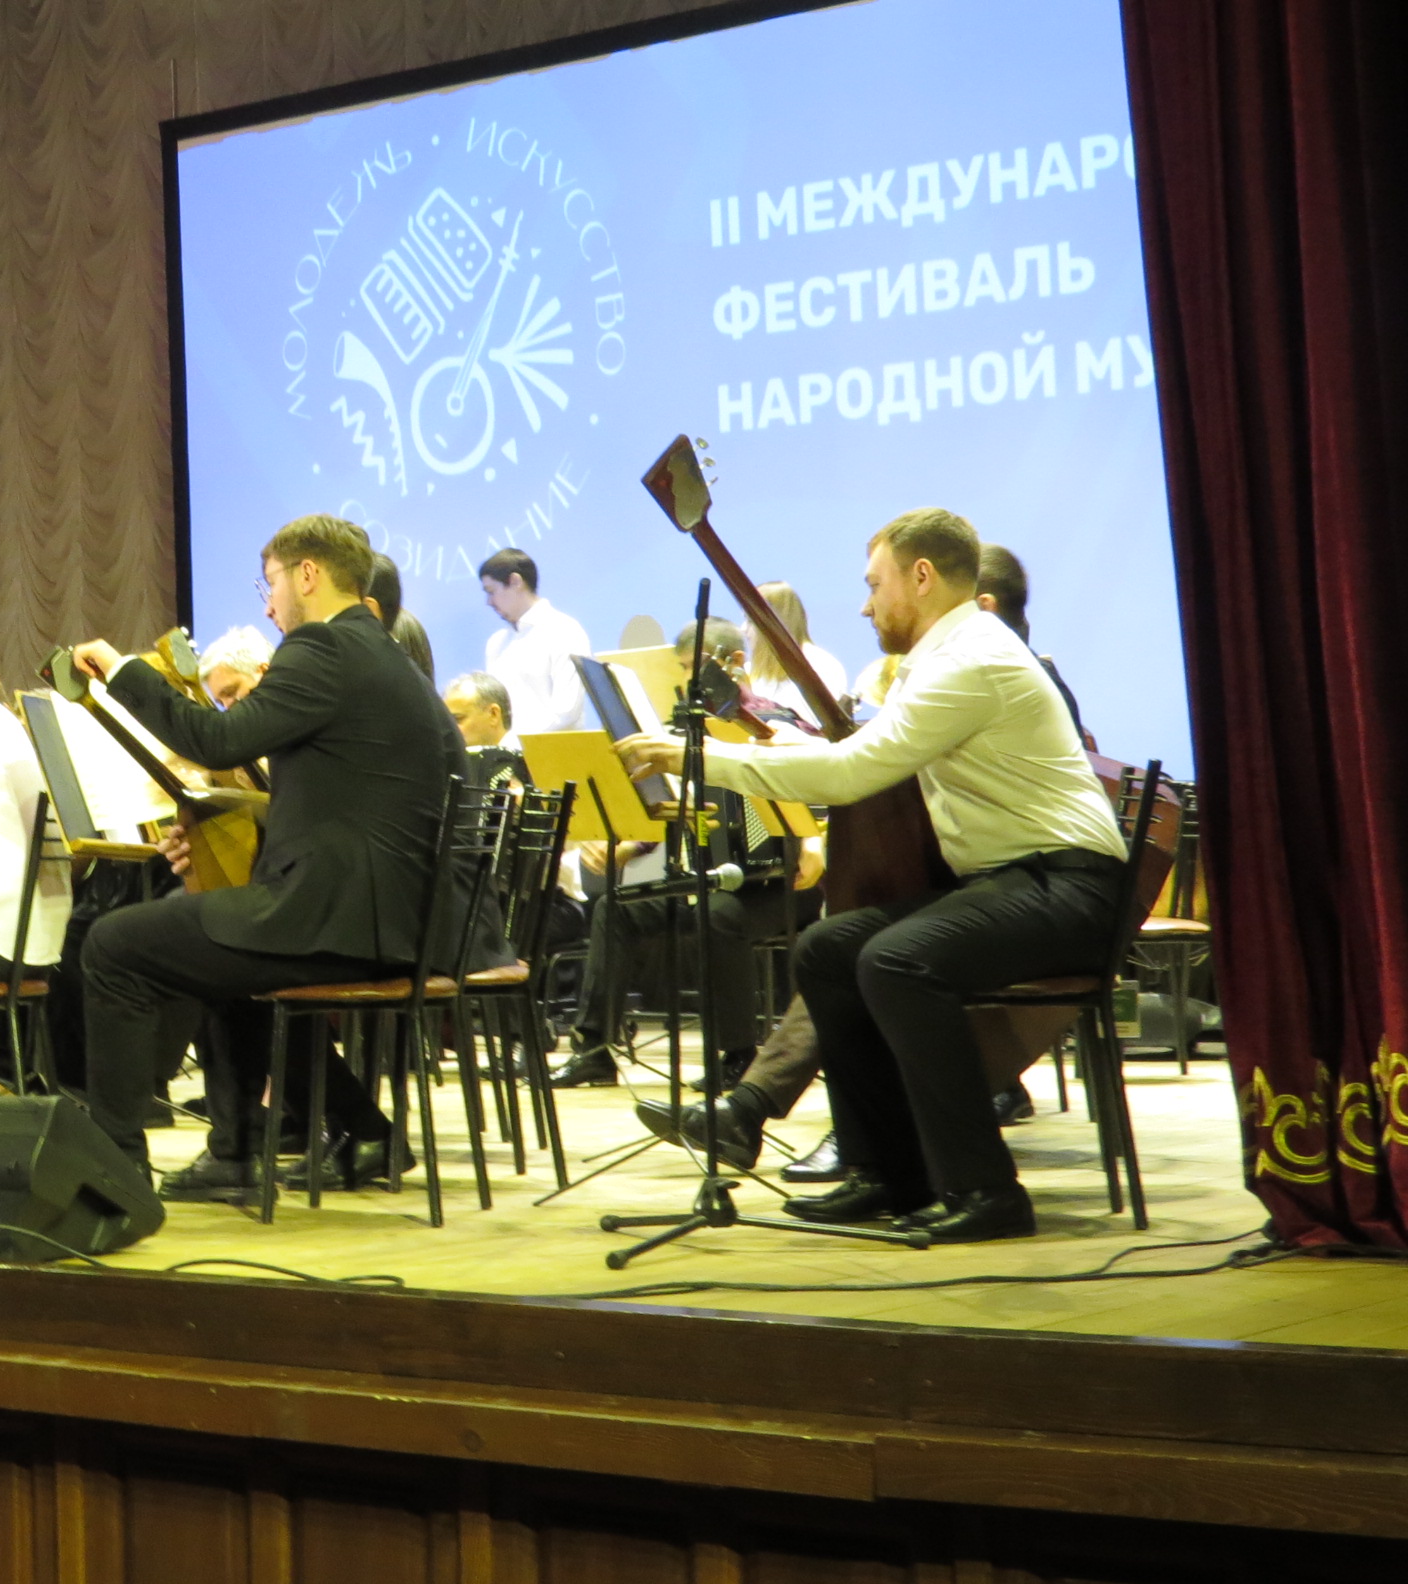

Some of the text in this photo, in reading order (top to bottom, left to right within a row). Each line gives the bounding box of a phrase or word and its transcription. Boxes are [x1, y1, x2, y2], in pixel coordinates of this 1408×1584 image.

[755, 132, 1136, 241] МЕЖДУНАР
[466, 116, 626, 376] ИСКУССТВО
[712, 240, 1096, 340] ФЕСТИВАЛЬ
[717, 329, 1057, 433] НАРОДНОЙ
